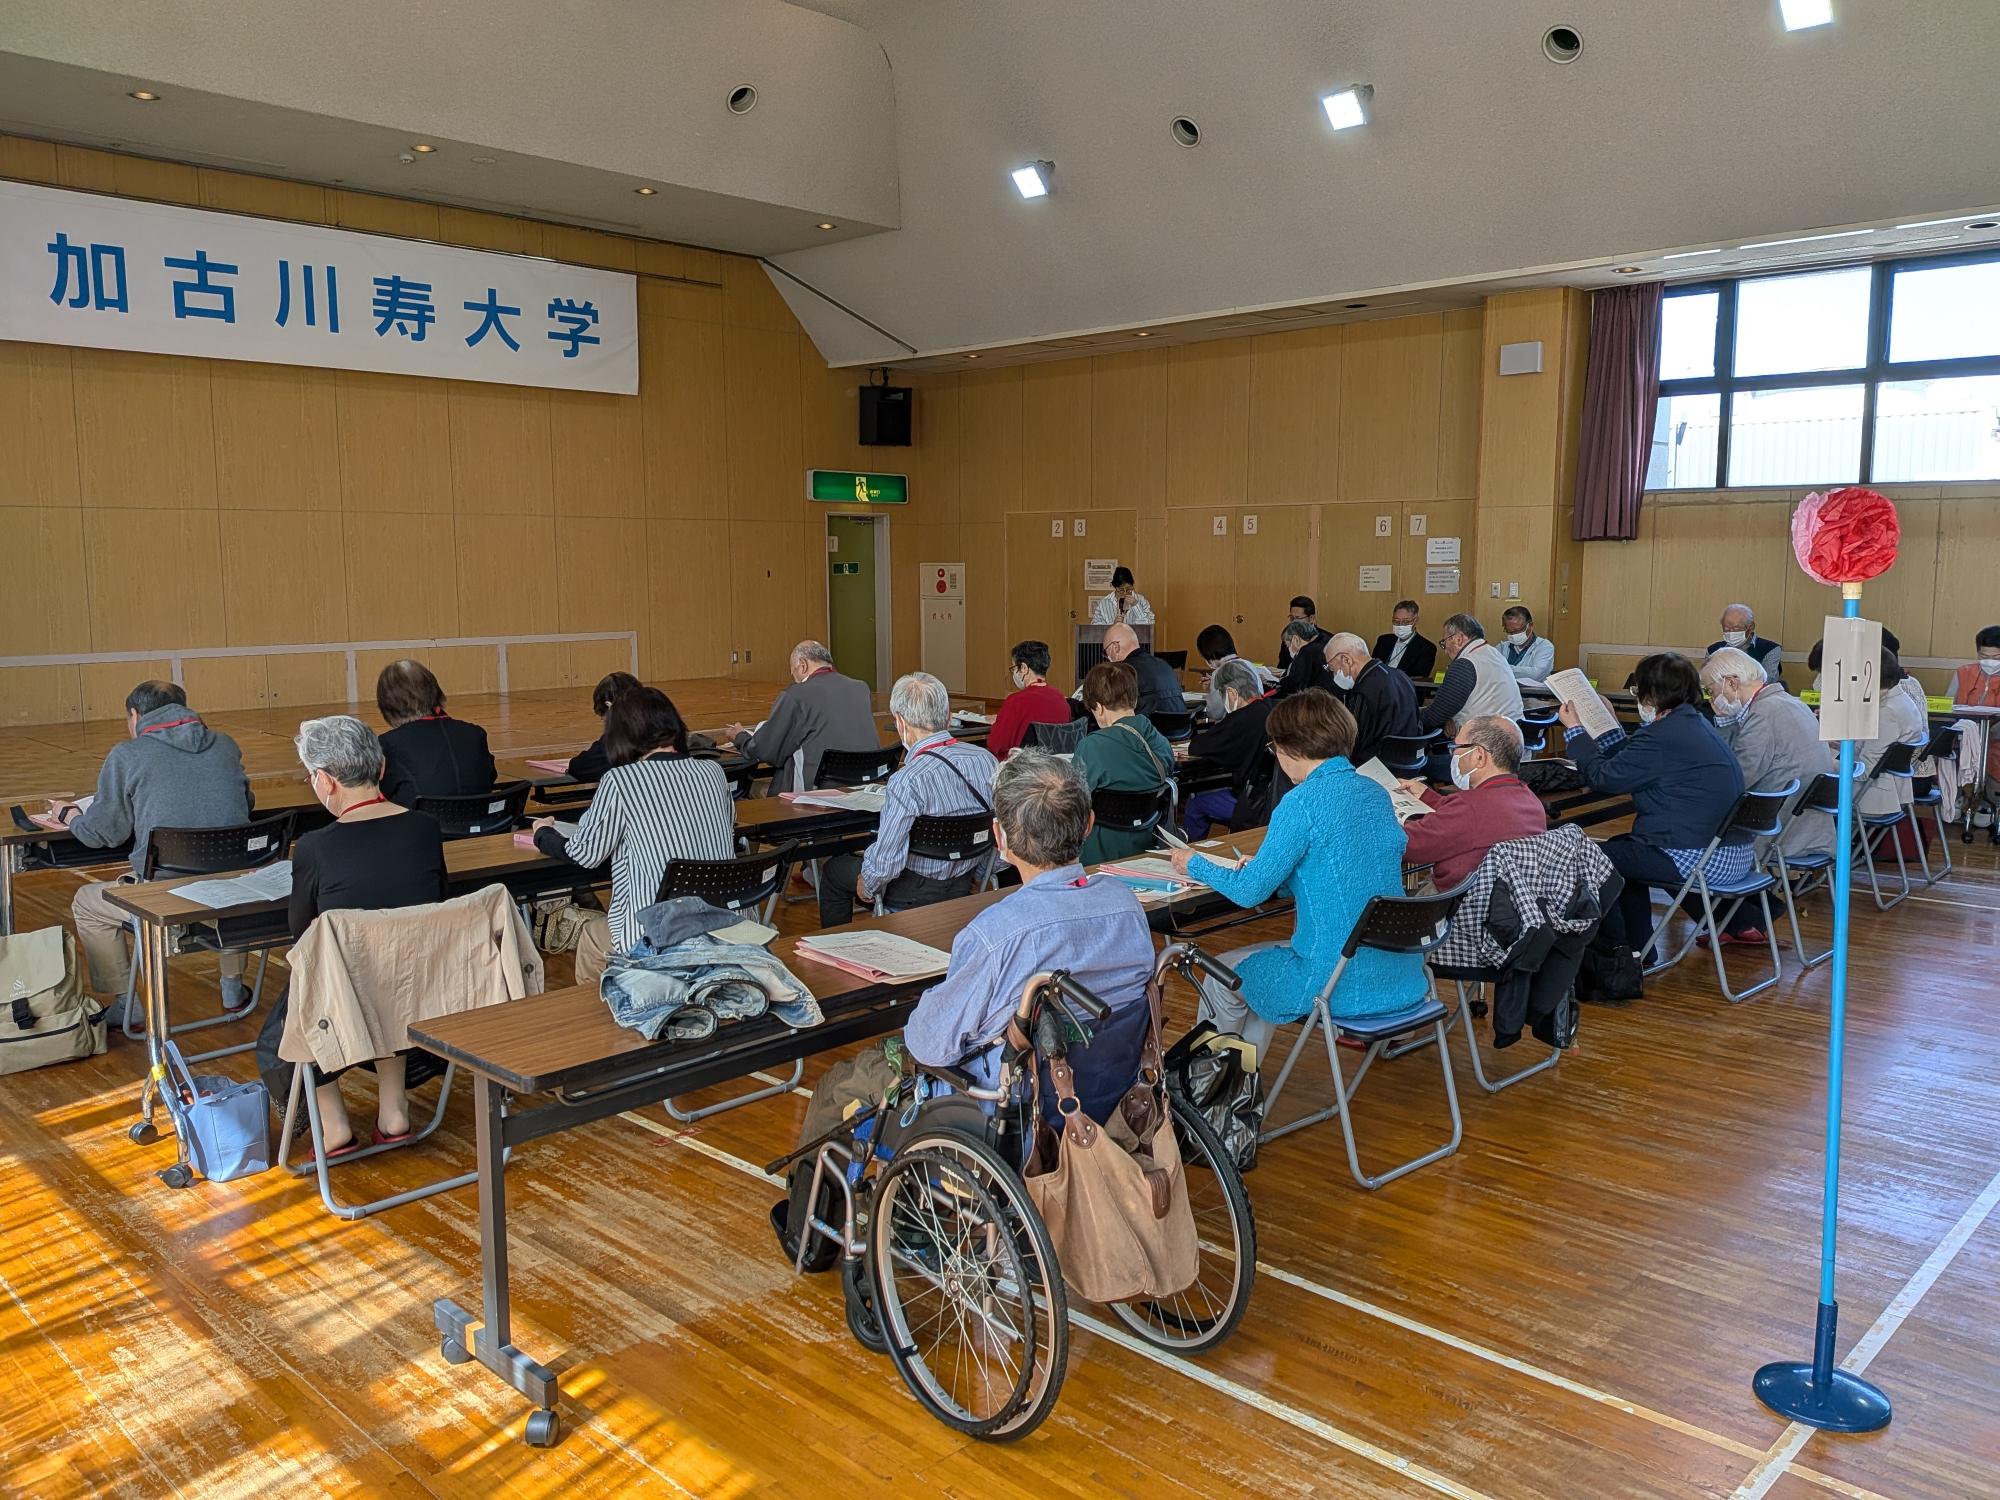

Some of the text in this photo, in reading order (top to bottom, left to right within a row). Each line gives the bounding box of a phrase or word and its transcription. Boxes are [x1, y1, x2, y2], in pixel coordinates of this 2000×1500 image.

[46, 232, 602, 359] 加古川寿大学
[1055, 522, 1061, 534] 2
[1077, 521, 1083, 533] 3
[1216, 519, 1223, 531] 4
[1247, 518, 1254, 530] 5
[1379, 518, 1387, 532] 6
[1415, 518, 1422, 531] 7
